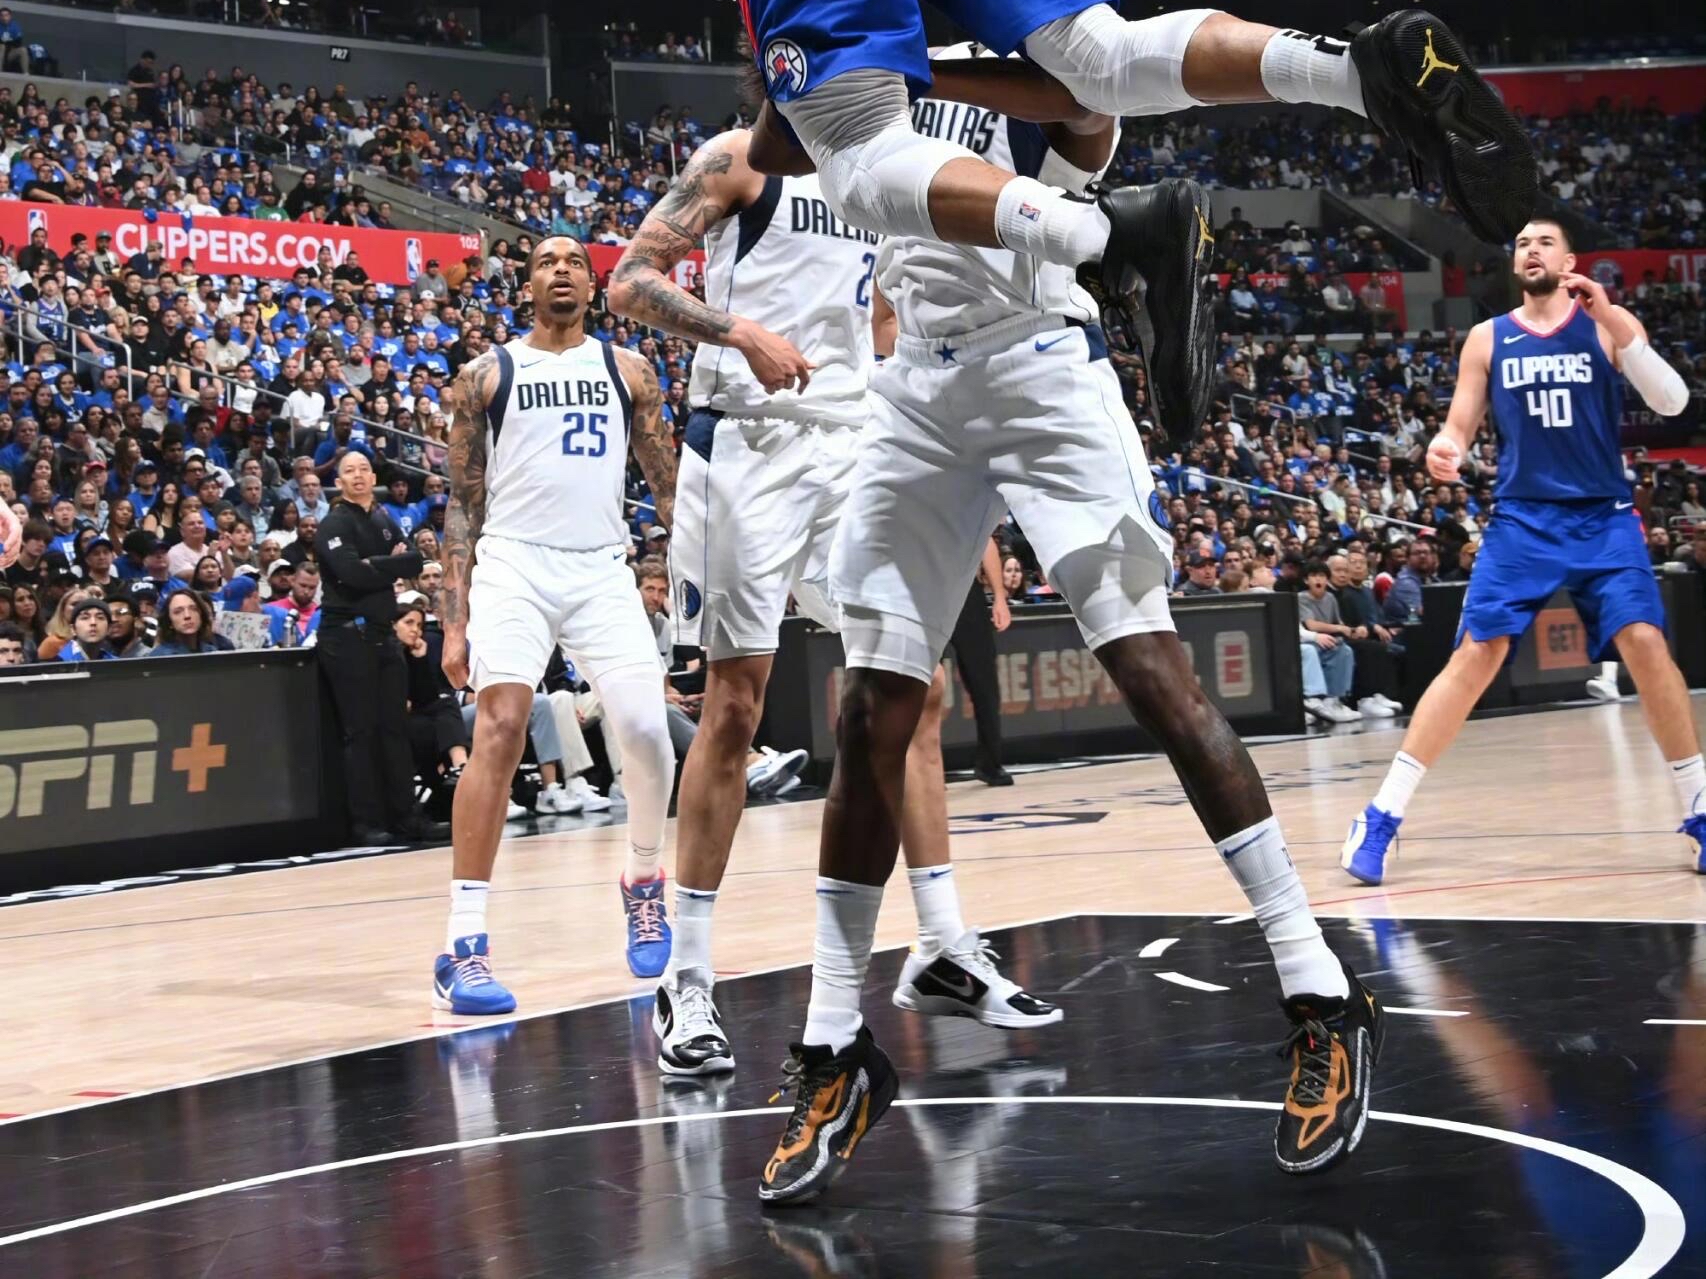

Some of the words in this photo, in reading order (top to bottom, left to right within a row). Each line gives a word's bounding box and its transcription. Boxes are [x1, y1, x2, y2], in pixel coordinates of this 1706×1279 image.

[459, 235, 480, 250] 102
[1502, 352, 1593, 389] CLIPPERS
[517, 380, 609, 411] DALLAS
[1526, 388, 1573, 428] 40
[562, 412, 608, 457] 25
